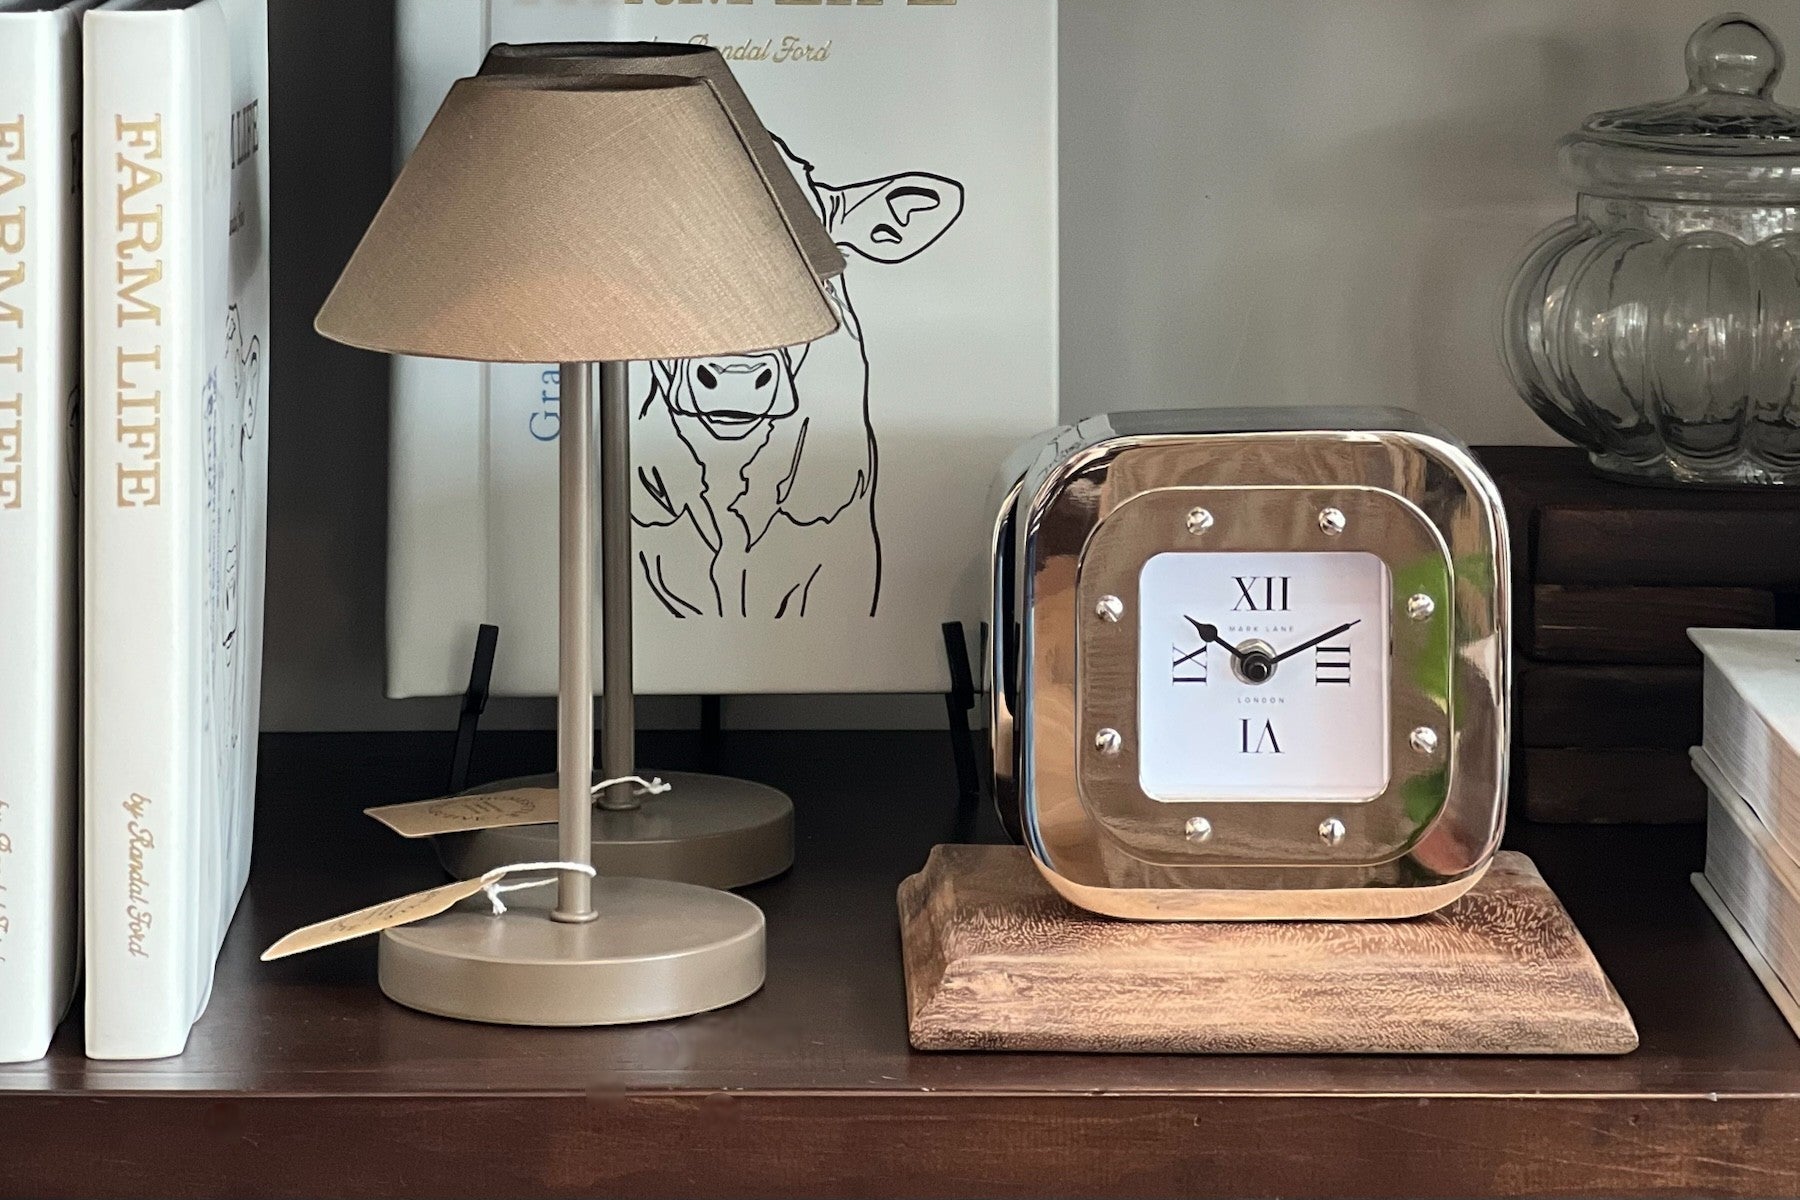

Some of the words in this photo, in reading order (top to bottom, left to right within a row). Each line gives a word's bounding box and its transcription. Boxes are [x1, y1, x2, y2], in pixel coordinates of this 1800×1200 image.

[772, 35, 833, 63] Ford
[115, 112, 164, 329] FARM
[115, 344, 162, 509] LIFE
[1230, 575, 1292, 612] XII
[1172, 642, 1209, 687] IX
[1314, 642, 1352, 688] III
[1237, 696, 1286, 704] LONDON
[1238, 718, 1286, 754] VI
[122, 792, 152, 820] by
[127, 820, 155, 904] Randal
[126, 904, 153, 959] Ford
